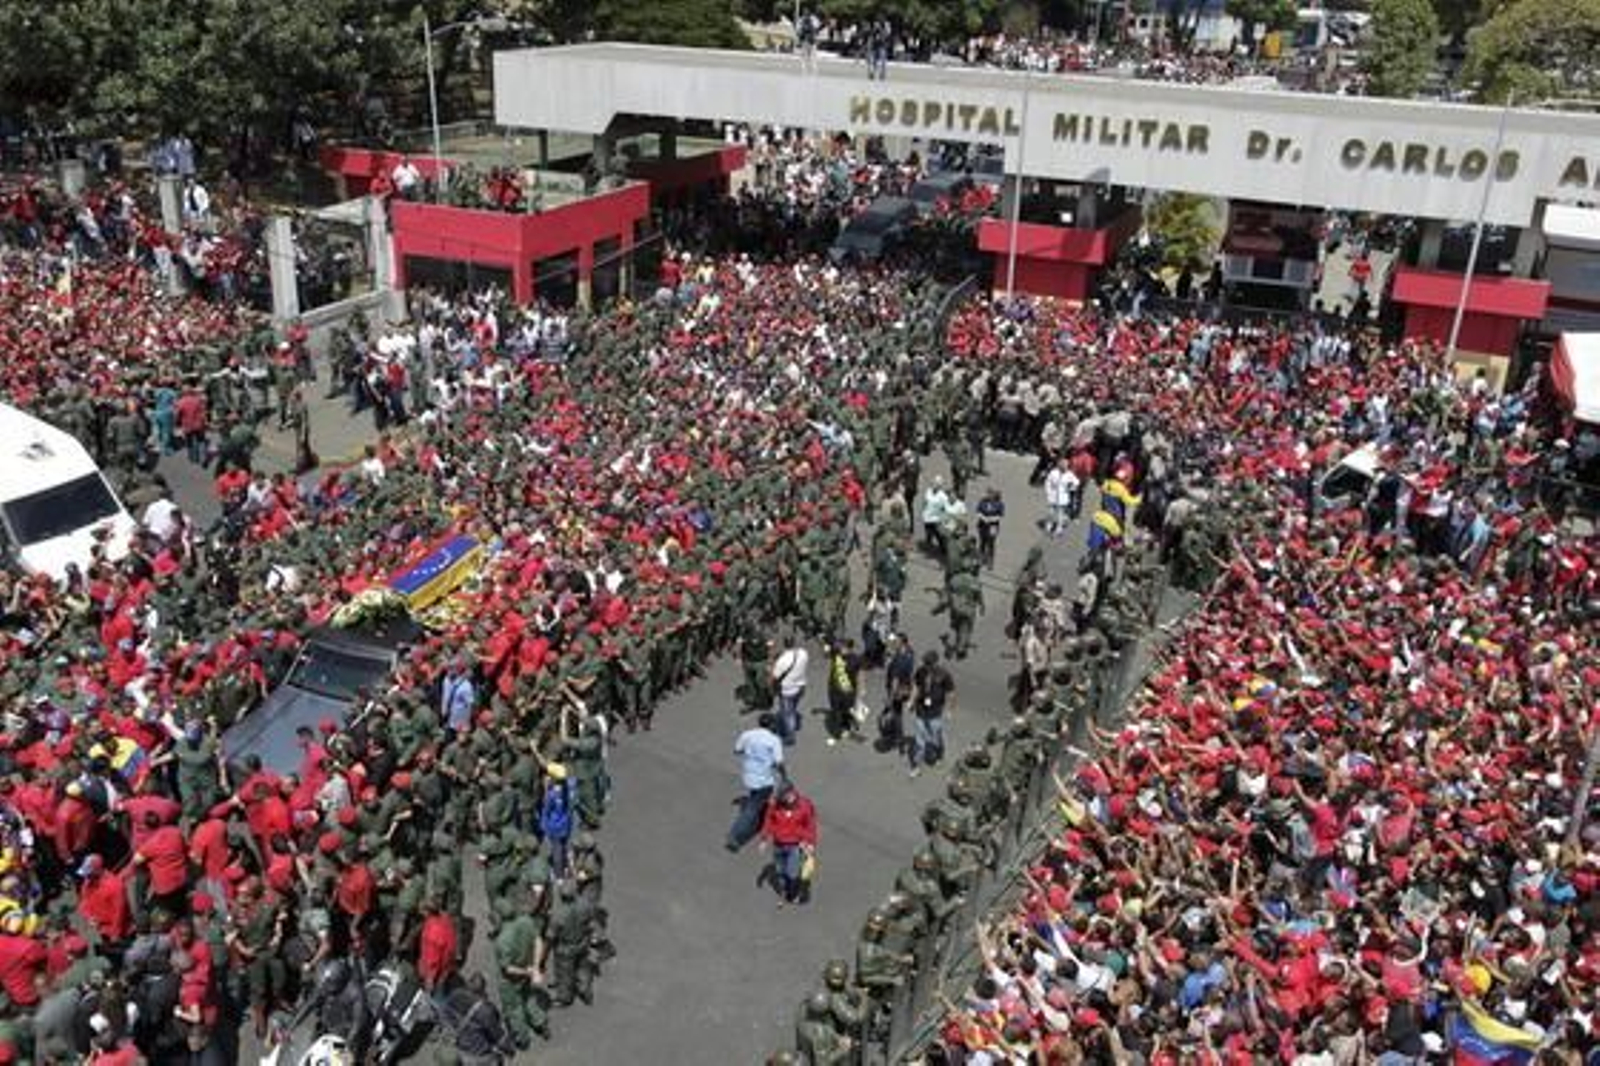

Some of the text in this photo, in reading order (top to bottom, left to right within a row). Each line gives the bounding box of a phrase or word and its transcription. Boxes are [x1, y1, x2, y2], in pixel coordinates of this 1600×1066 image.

[850, 96, 1600, 191] HOSPITAL MILITAR Dr. CARLOS A
